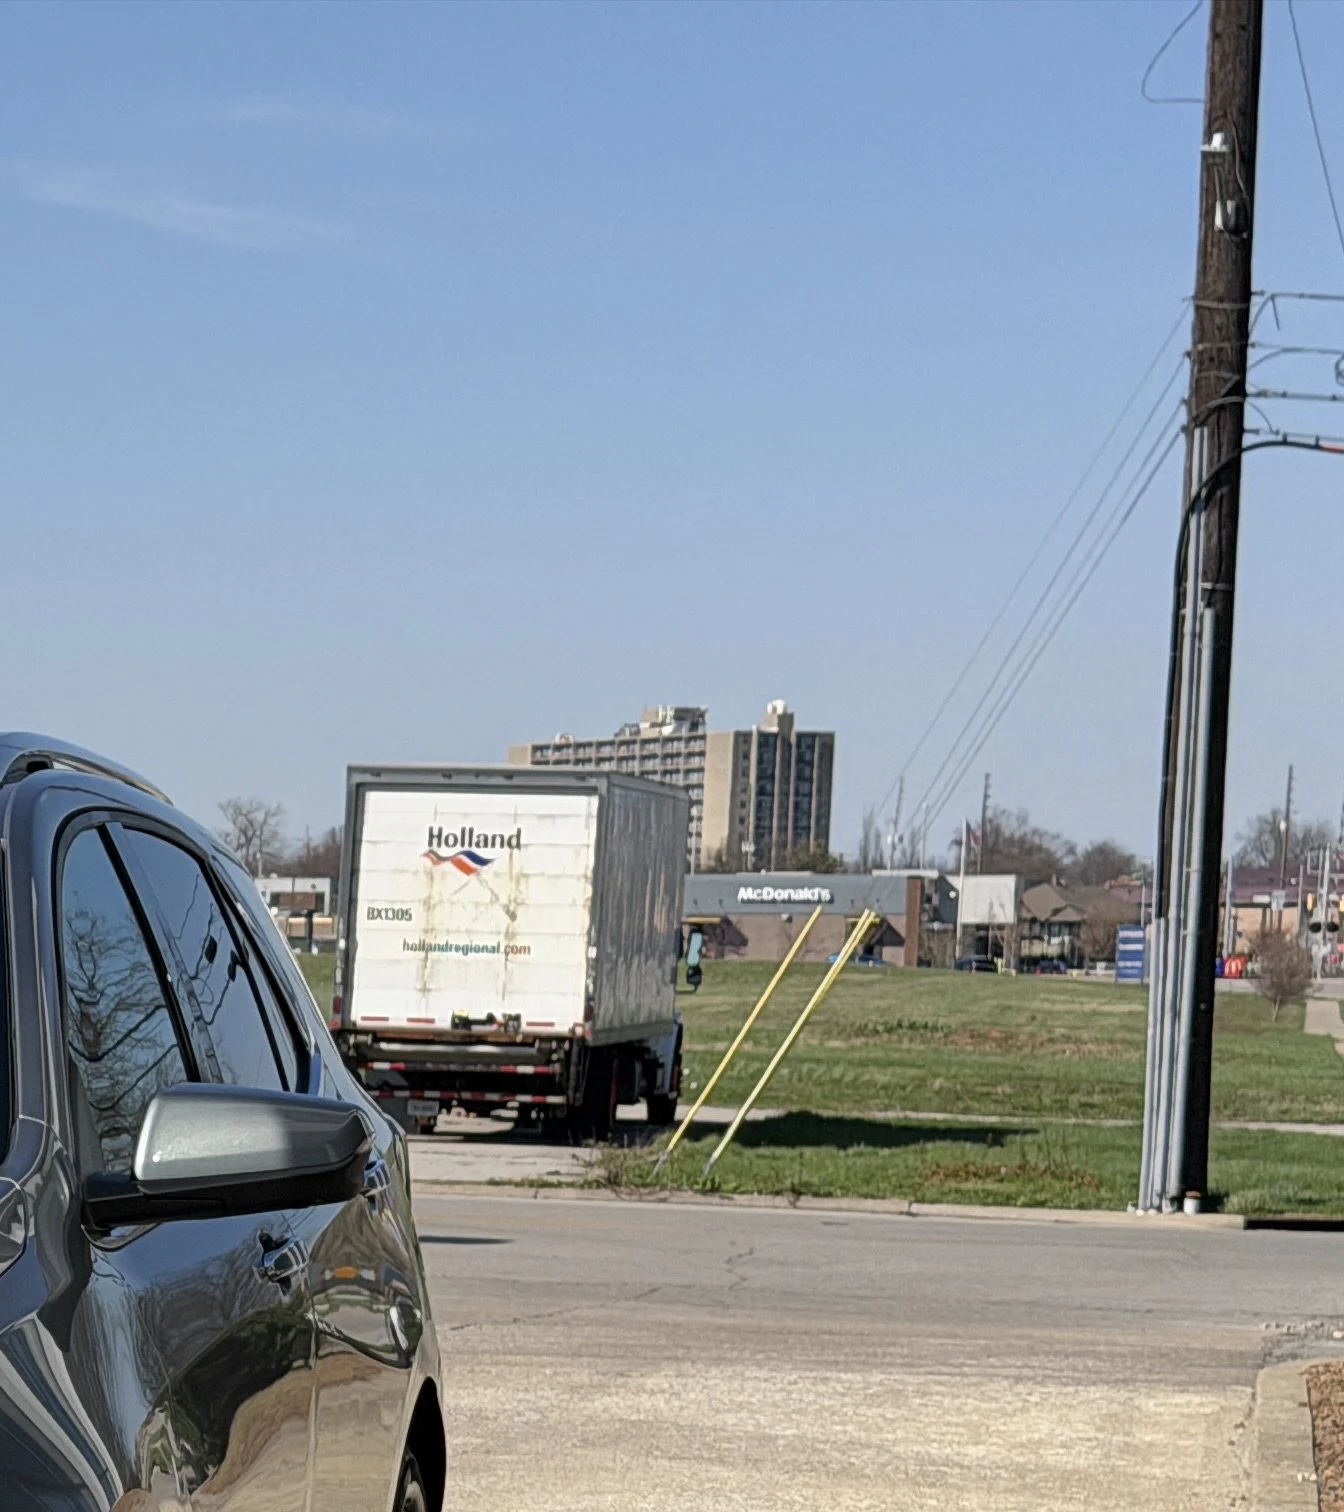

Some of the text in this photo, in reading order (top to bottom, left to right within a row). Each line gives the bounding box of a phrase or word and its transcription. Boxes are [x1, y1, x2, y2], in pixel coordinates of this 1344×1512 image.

[427, 826, 522, 850] Holland
[737, 886, 831, 903] McDonald's
[366, 906, 413, 922] BX1305
